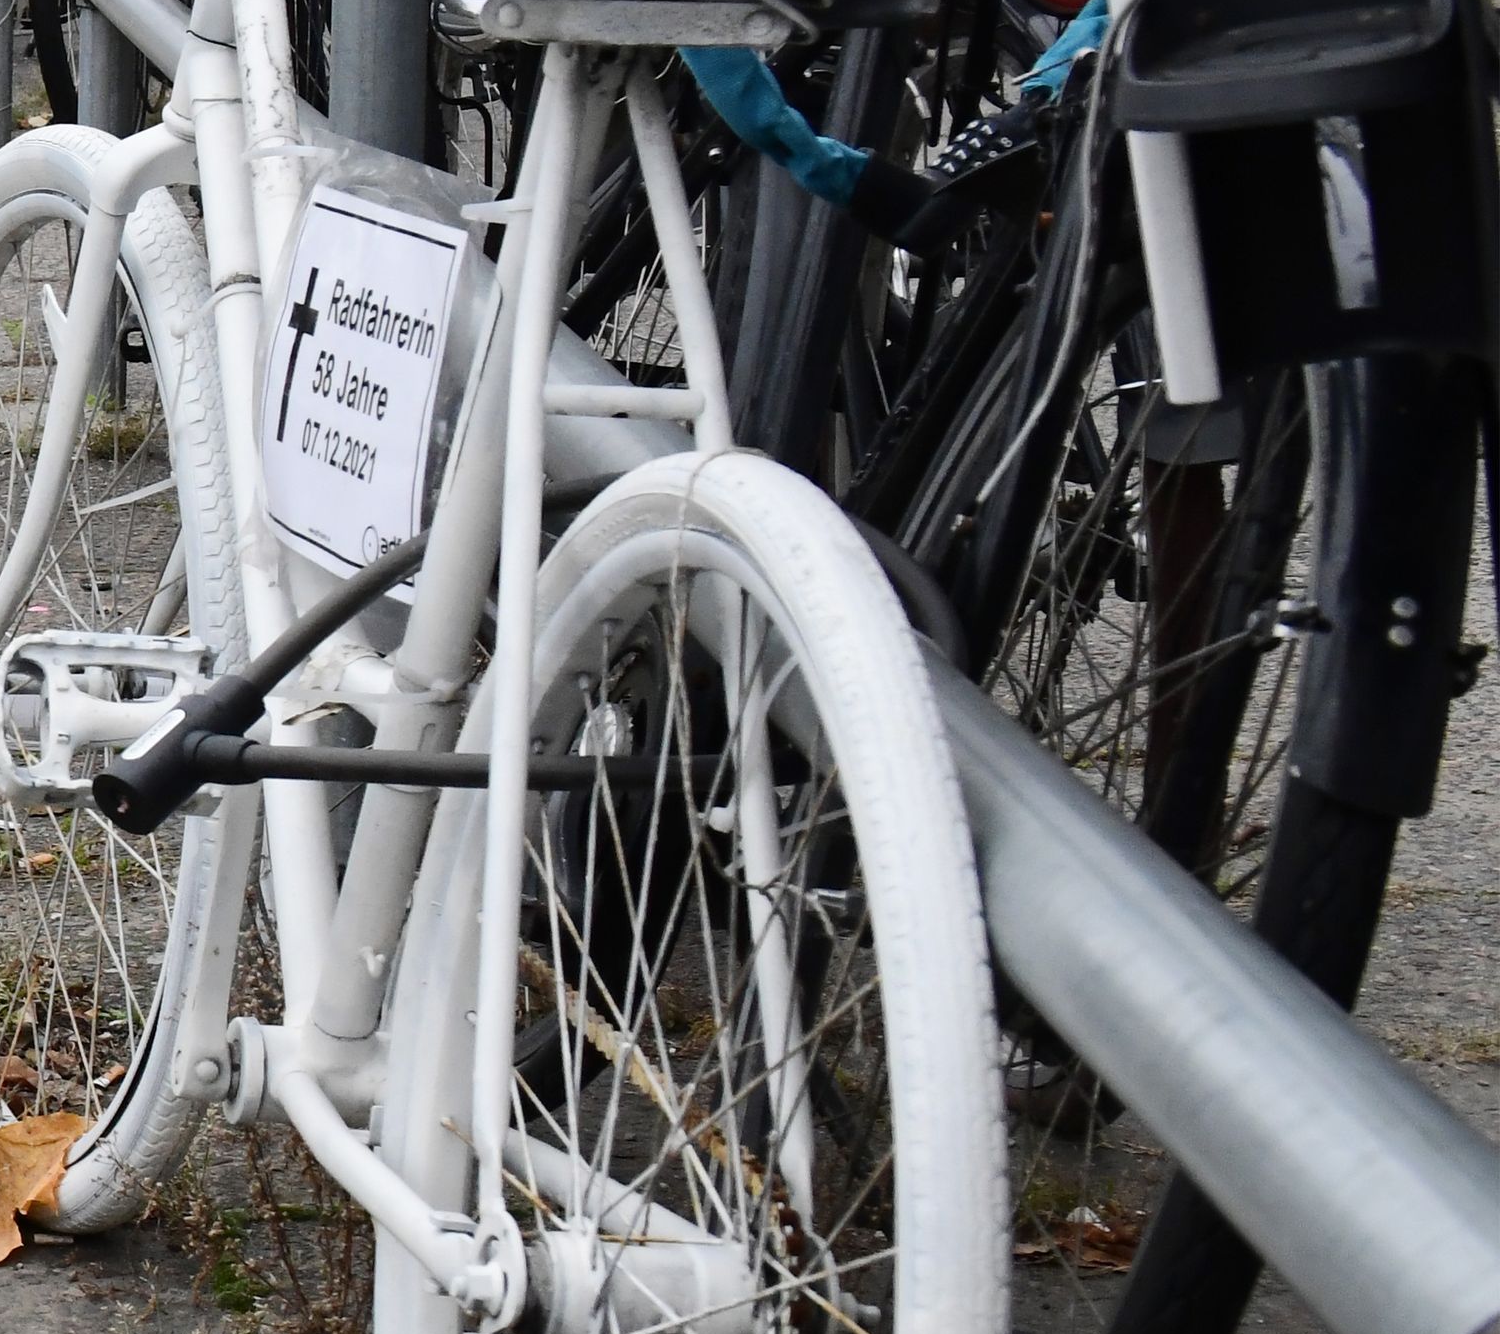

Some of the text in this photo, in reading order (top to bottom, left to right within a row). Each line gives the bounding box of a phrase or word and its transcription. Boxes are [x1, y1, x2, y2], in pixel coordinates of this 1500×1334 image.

[327, 278, 436, 359] Radfahrerin
[312, 350, 389, 421] 58 Jahre
[302, 418, 377, 484] 07.12.2021
